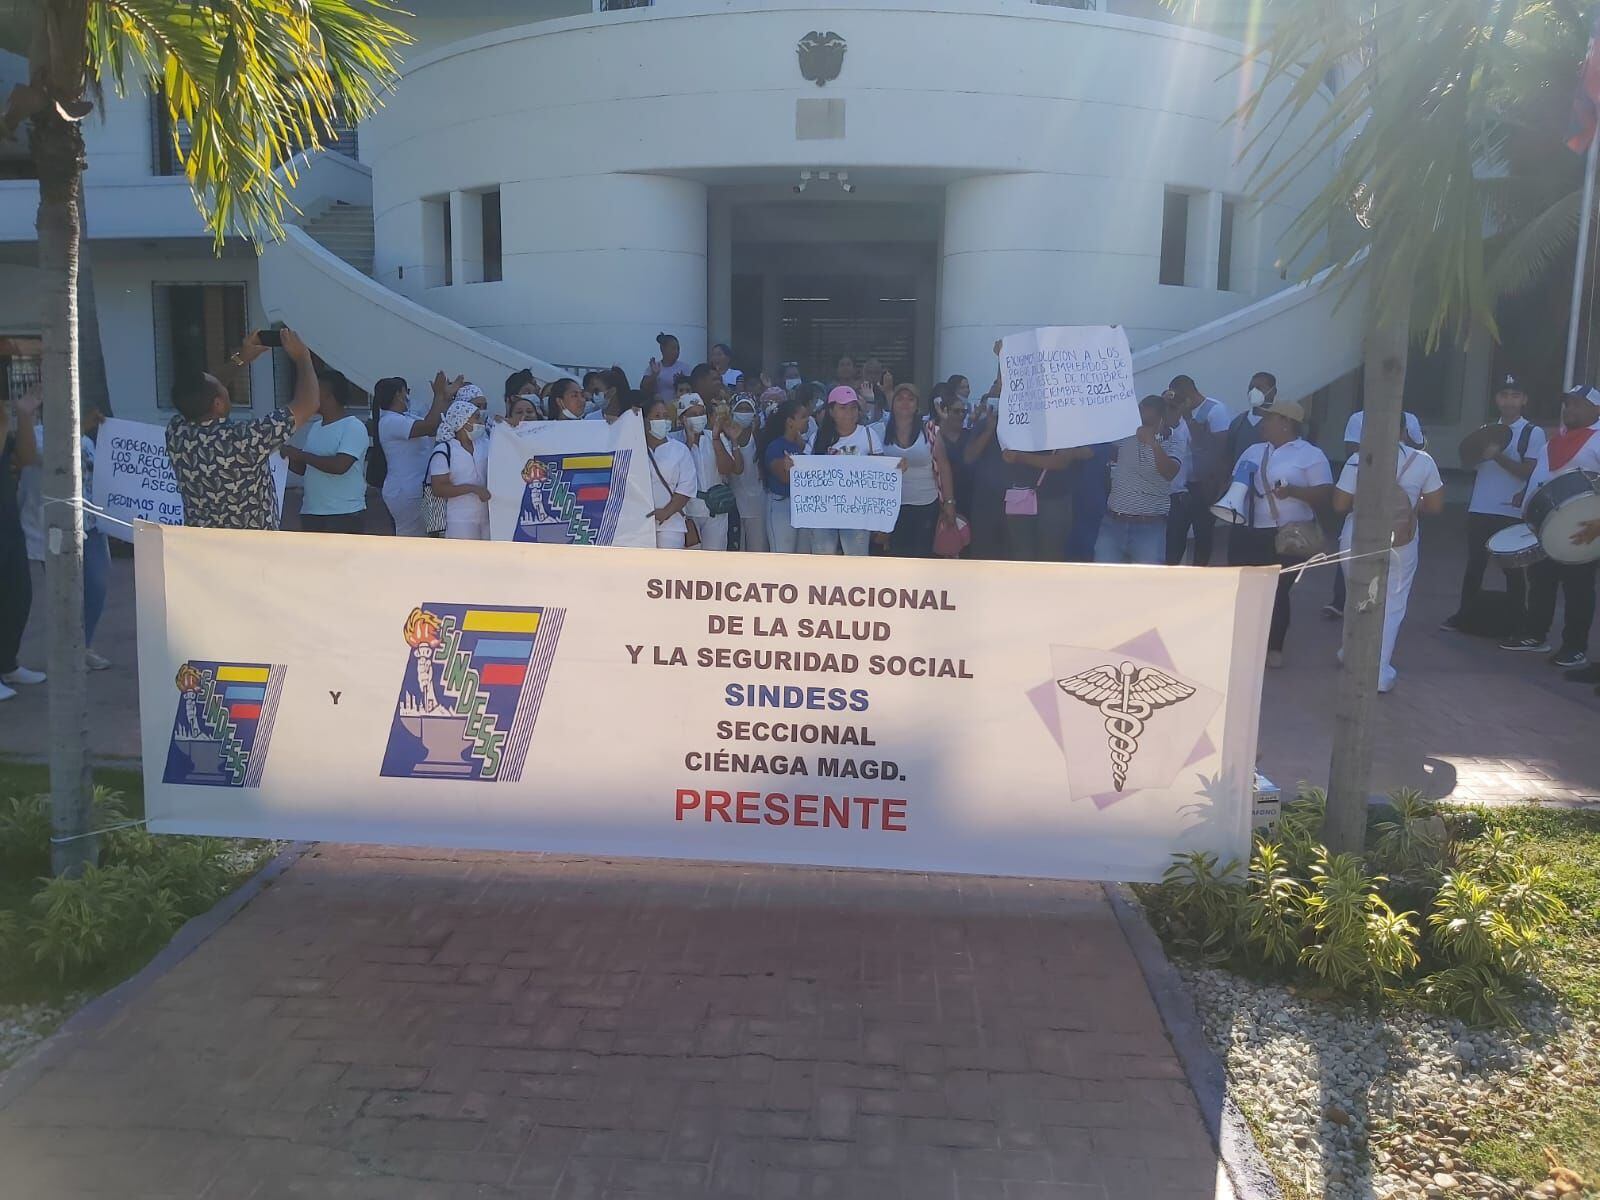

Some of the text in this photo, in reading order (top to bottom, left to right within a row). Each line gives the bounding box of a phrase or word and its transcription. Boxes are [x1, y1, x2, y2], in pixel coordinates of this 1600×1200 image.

[1084, 350, 1092, 361] A
[1087, 383, 1112, 395] 2021
[1008, 412, 1031, 425] 2022
[111, 450, 173, 470] LOS RECU
[793, 469, 898, 483] QUEREMOS NUESTROS
[793, 479, 896, 490] SUELDOS COMPLETOS
[107, 493, 182, 516] PEDIMOS QUE
[794, 494, 897, 508] CUMPLIMOS NUESTRAS
[796, 503, 828, 514] HORAS
[646, 578, 957, 611] SINDICATO NACIONAL
[708, 614, 892, 642] DE LA SALUD
[625, 644, 974, 679] Y LA SEGURIDAD SOCIAL
[329, 690, 342, 705] Y
[433, 615, 508, 778] SINDESS
[725, 683, 870, 712] SINDESS
[196, 669, 250, 785] SINDESS
[716, 720, 876, 747] SECCIONAL
[684, 748, 907, 782] CIÉNAGA MAGD.
[675, 788, 908, 832] PRESENTE
